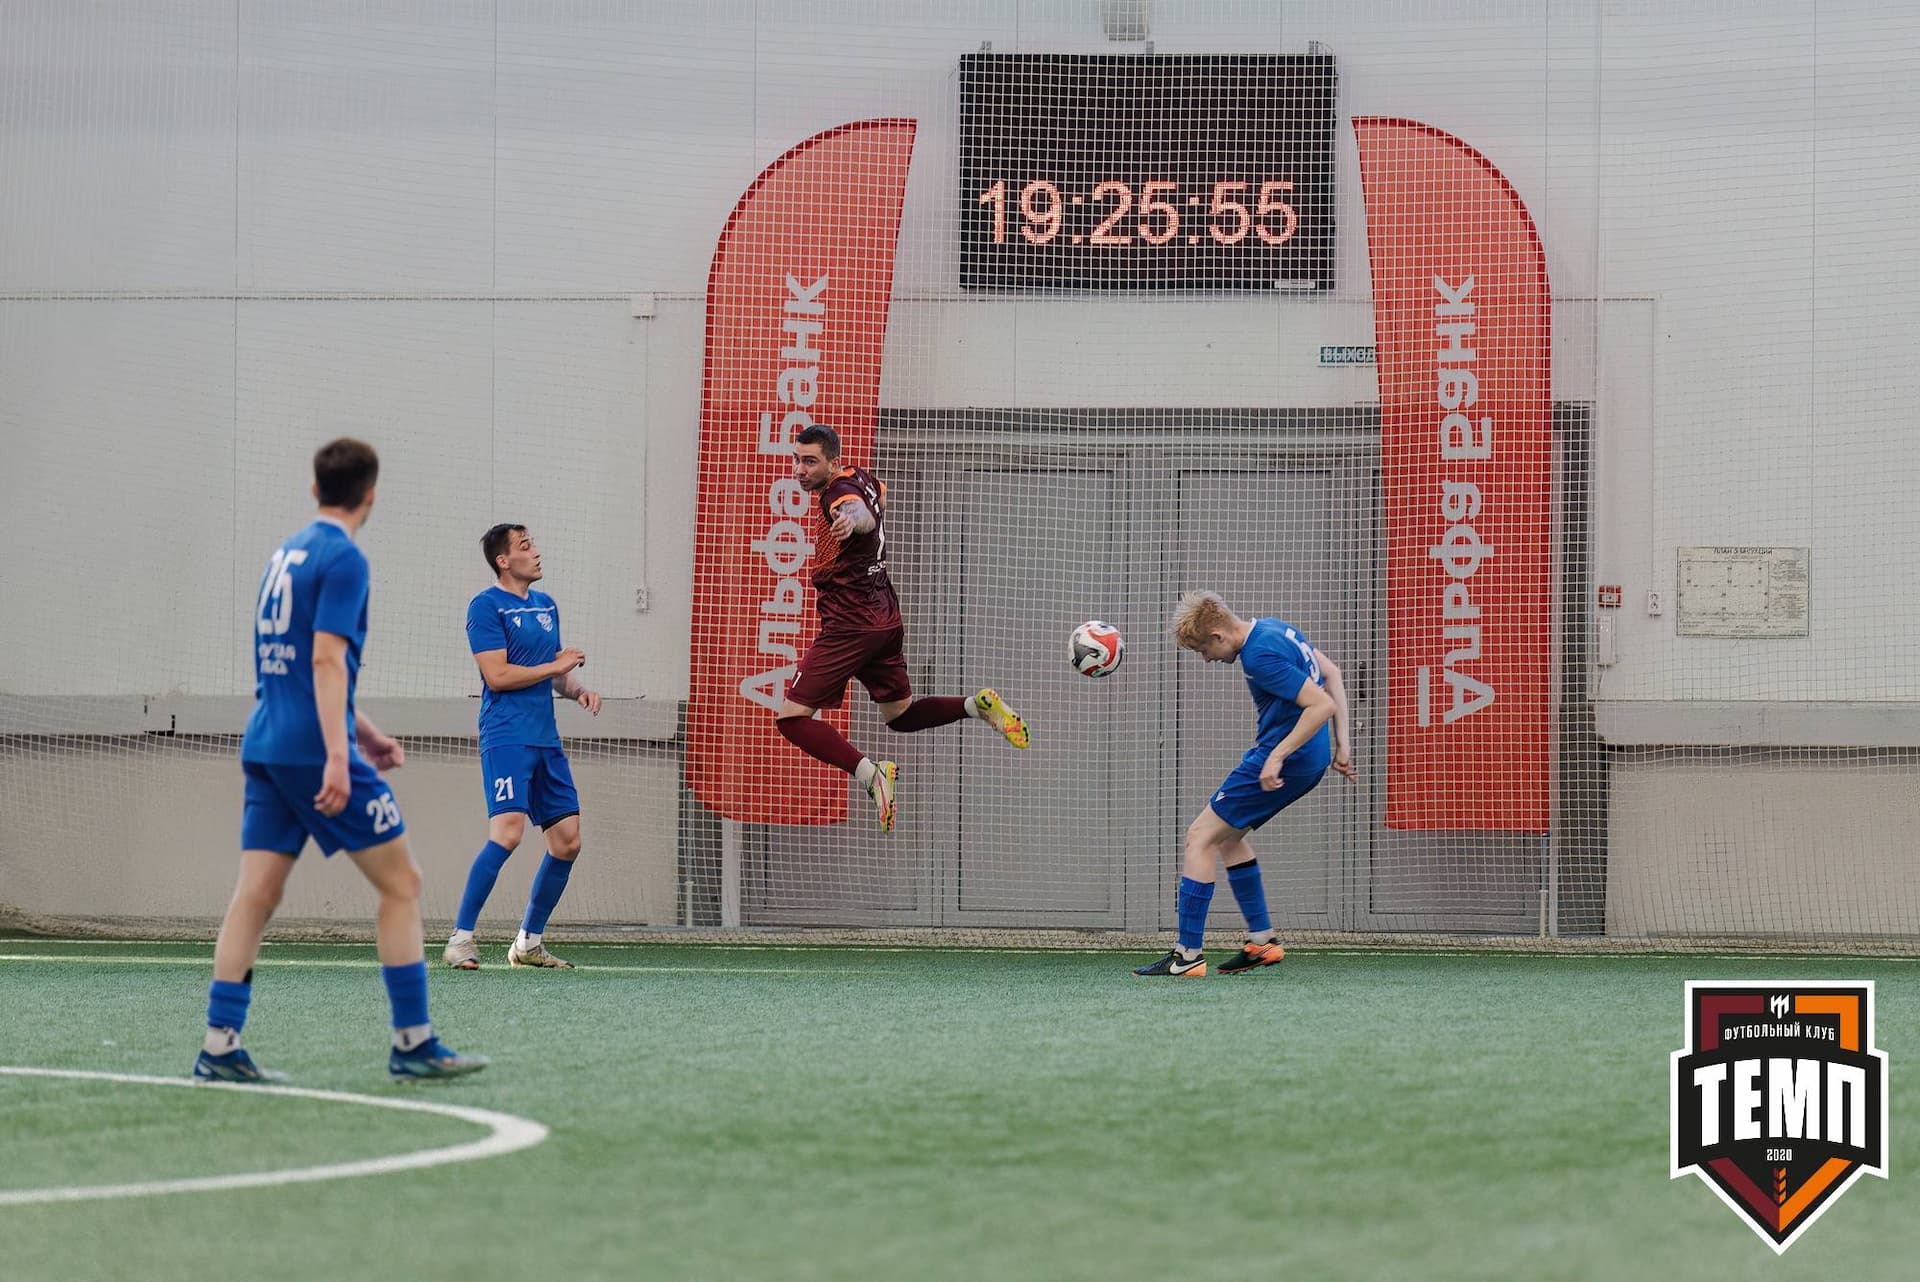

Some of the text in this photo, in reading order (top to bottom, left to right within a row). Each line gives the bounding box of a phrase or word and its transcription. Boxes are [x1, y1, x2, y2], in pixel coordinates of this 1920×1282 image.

[979, 180, 1297, 245] 19:25:55
[258, 549, 309, 635] 25
[366, 791, 401, 834] 25
[494, 776, 514, 802] 21
